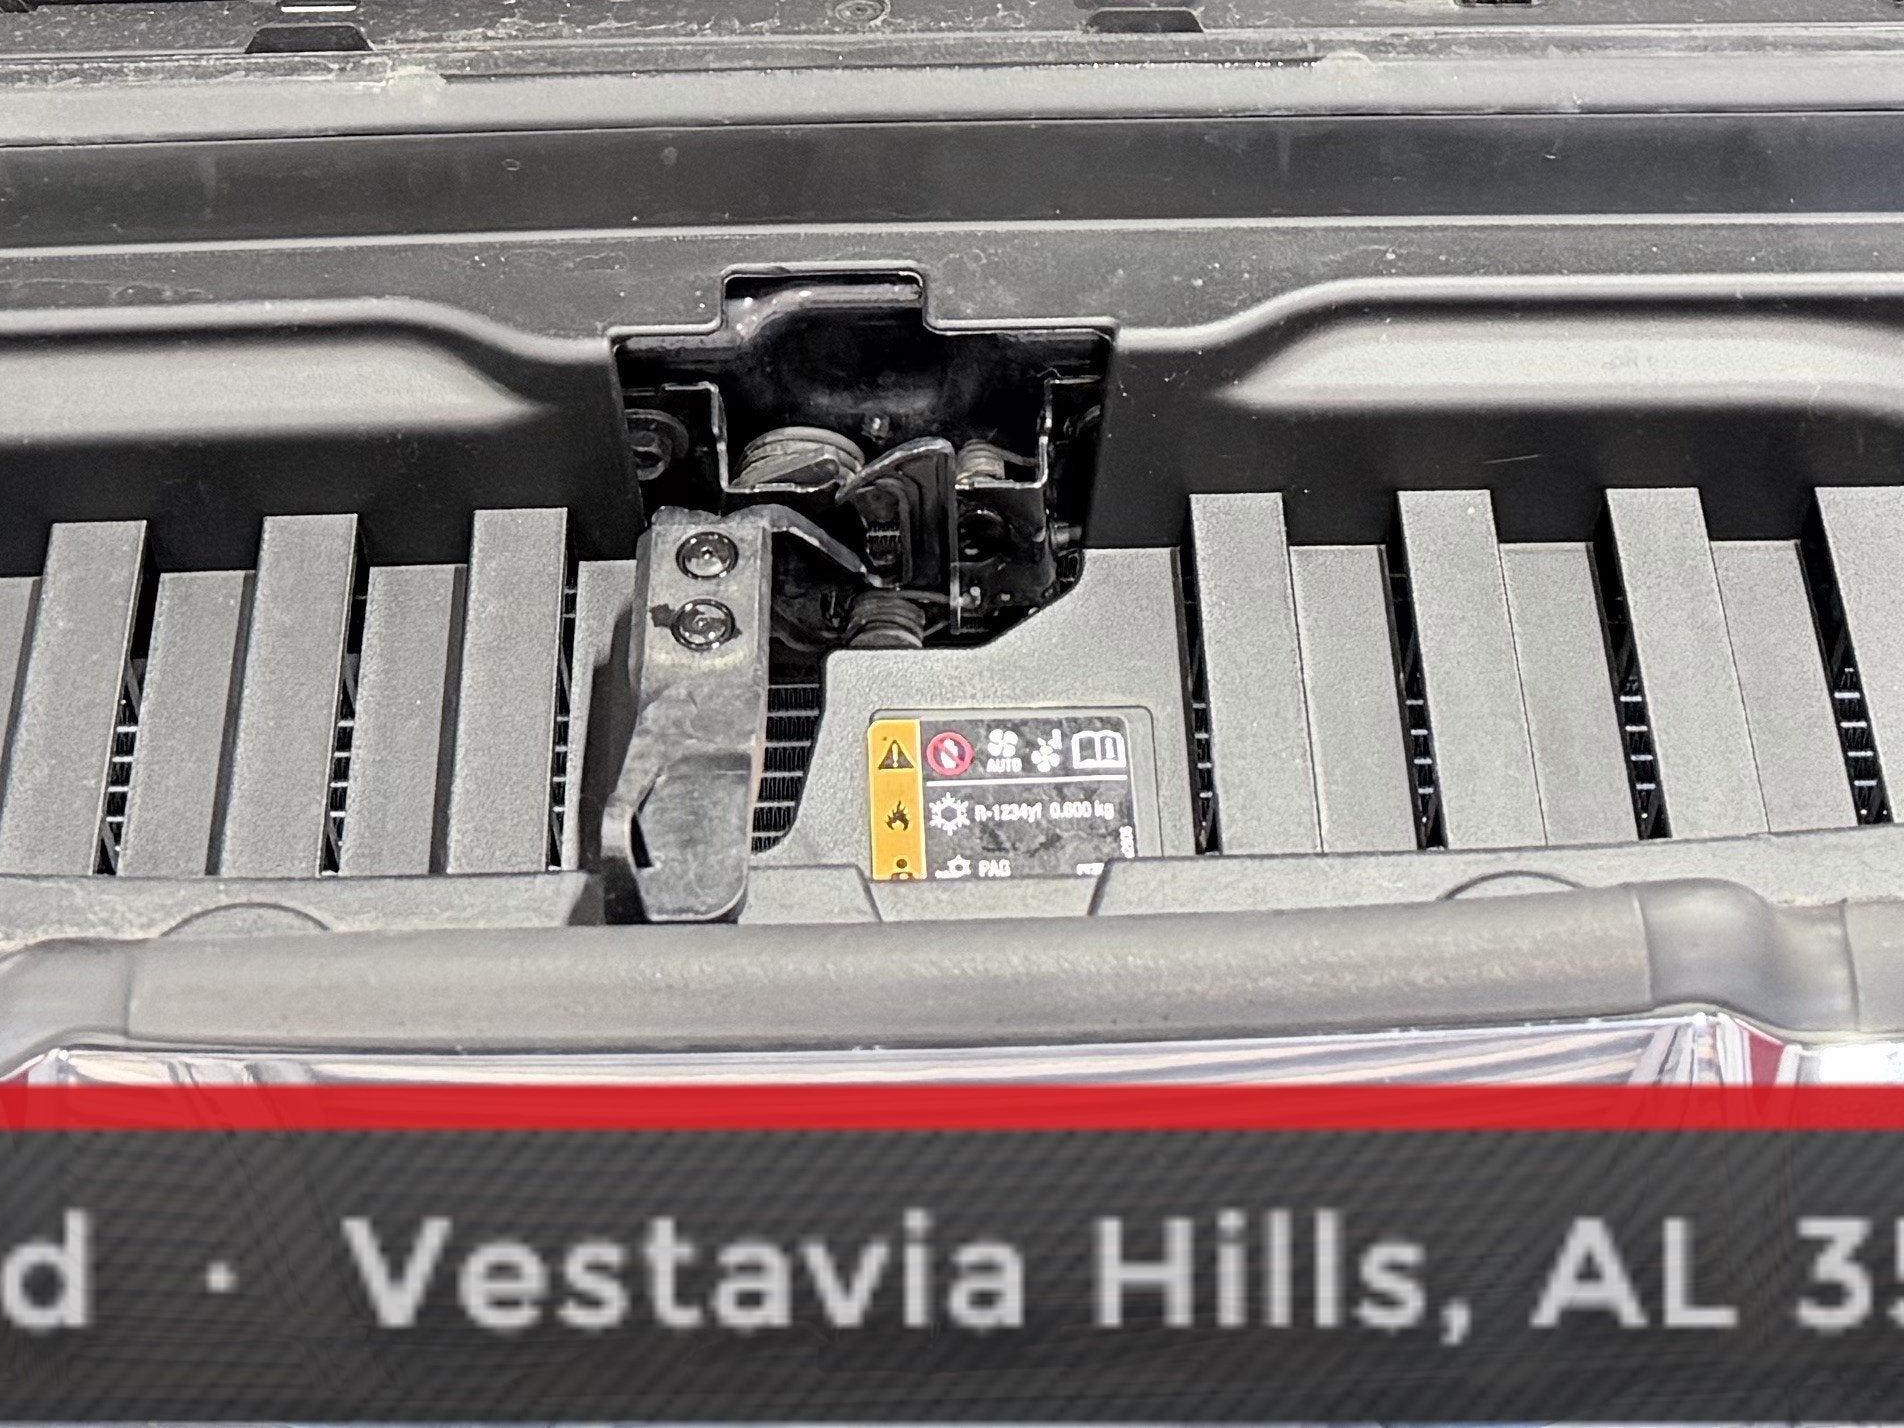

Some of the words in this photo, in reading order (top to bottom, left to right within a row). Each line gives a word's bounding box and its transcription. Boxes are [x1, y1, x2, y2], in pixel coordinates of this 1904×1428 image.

[986, 757, 1023, 773] AUTO
[1094, 799, 1115, 821] kg
[978, 858, 1012, 878] PAG
